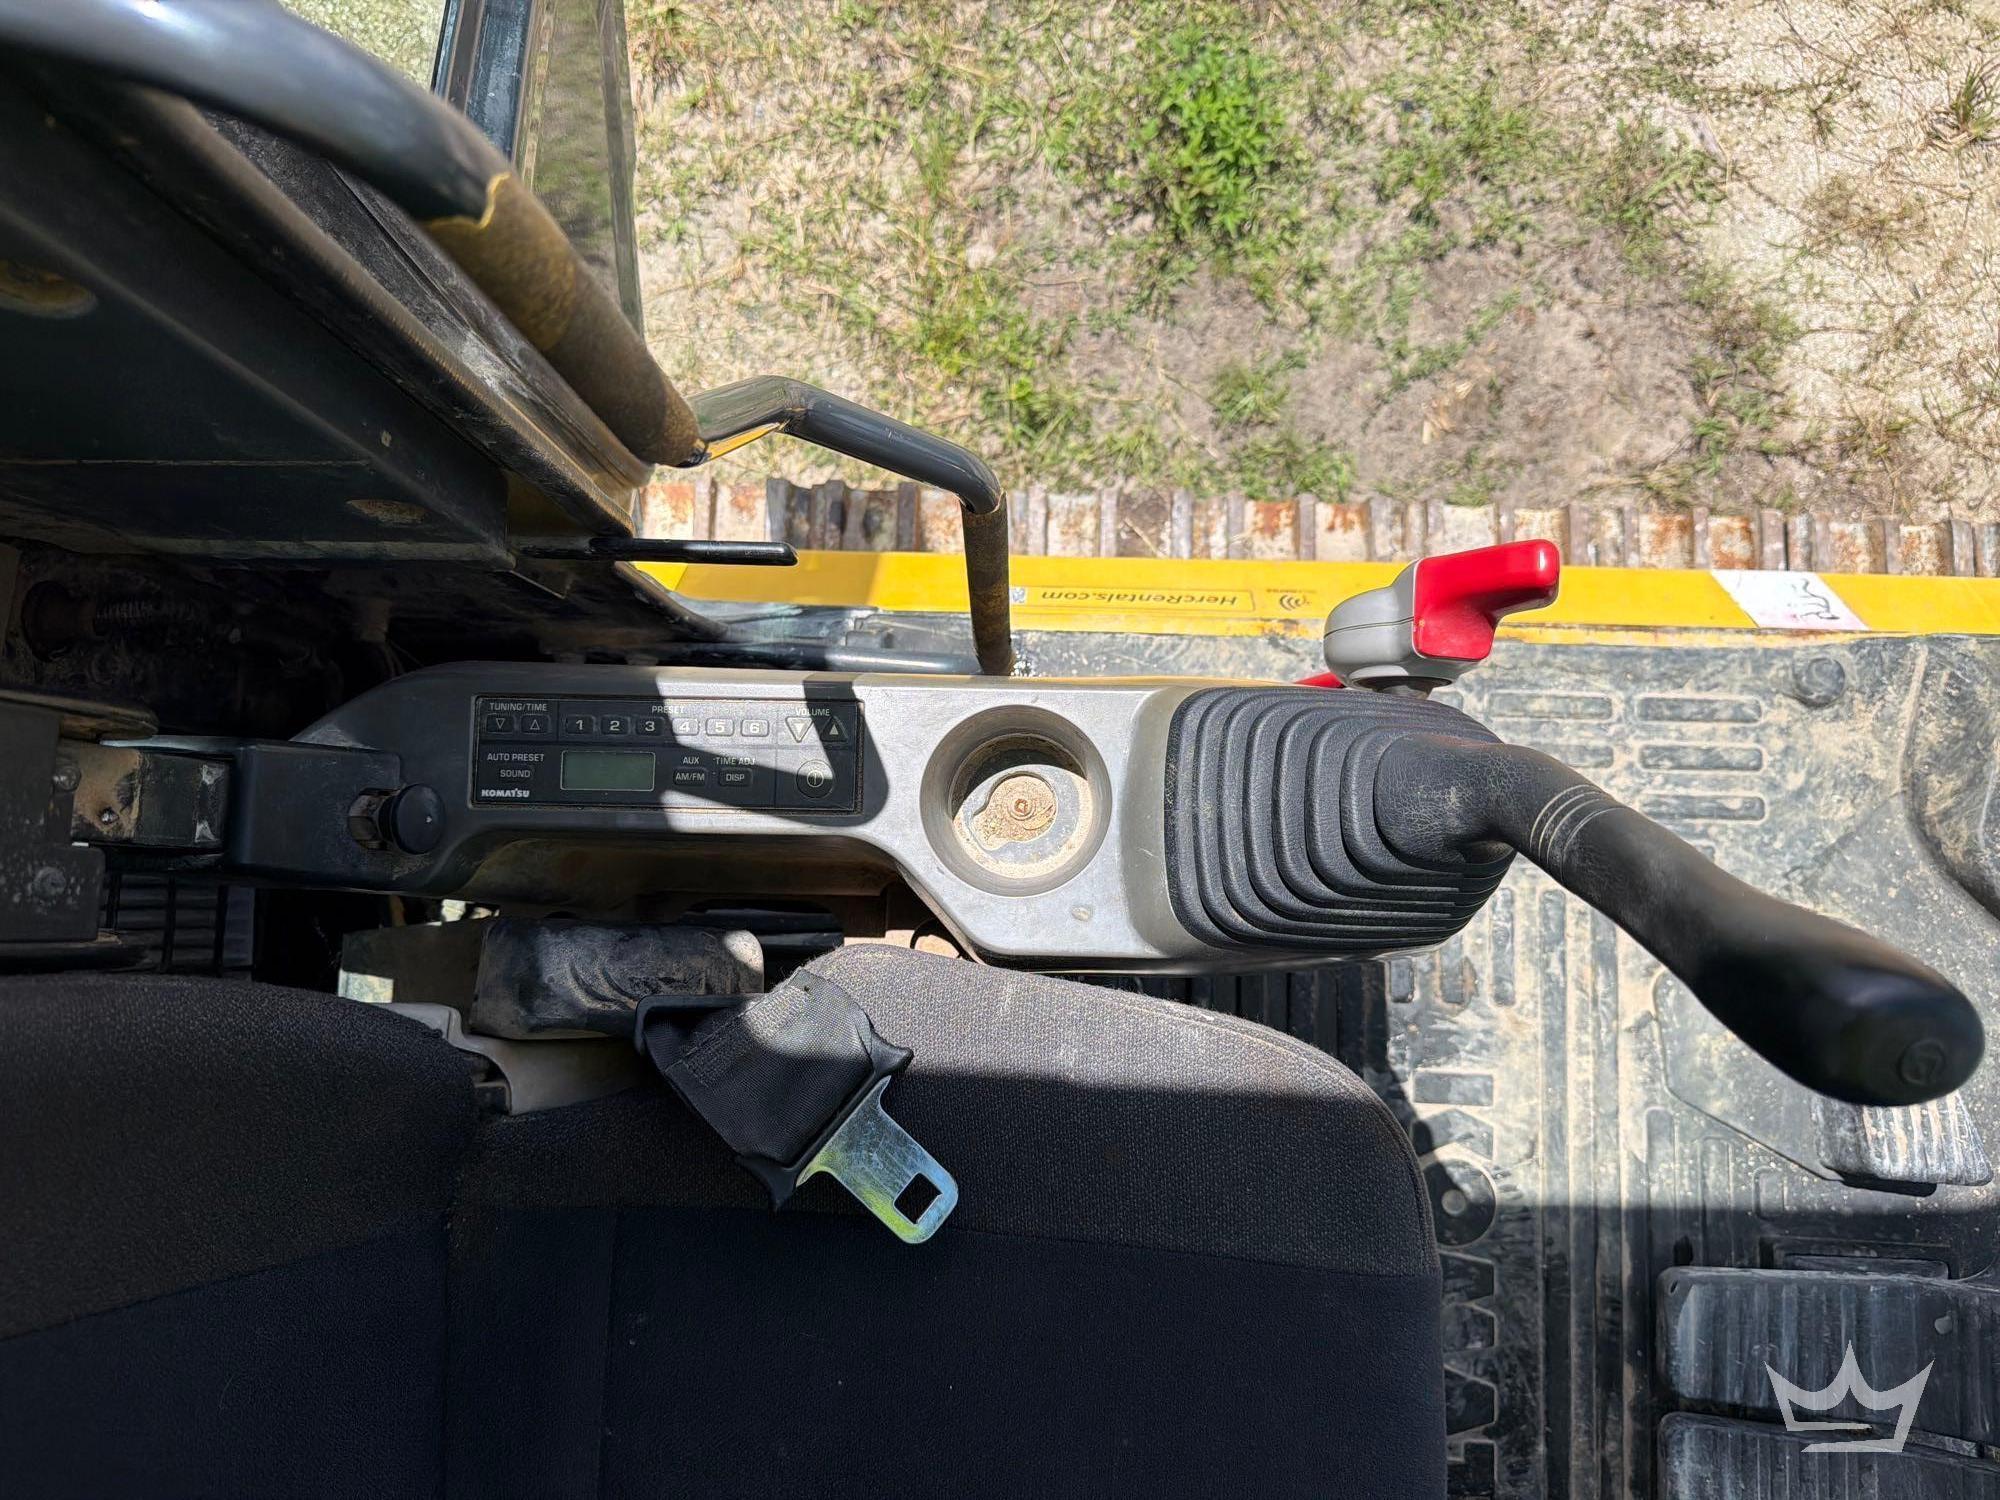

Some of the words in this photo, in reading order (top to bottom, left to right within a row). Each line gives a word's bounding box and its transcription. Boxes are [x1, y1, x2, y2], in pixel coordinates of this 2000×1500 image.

[1041, 590, 1237, 606] HercRentals.com
[489, 702, 548, 712] TUNING/TIME
[651, 705, 685, 714] PRESET
[795, 708, 830, 716] VOLUME
[575, 720, 584, 731] 1
[609, 720, 620, 731] 2
[644, 721, 656, 732] 3
[679, 721, 690, 733] 4
[714, 721, 726, 733] 5
[750, 721, 760, 733] 6
[486, 753, 511, 762] AUTO
[512, 753, 545, 762] PRESET
[682, 756, 700, 765] AUX
[715, 757, 736, 766] TIME
[738, 757, 756, 766] ADJ
[500, 769, 531, 778] SOUND
[675, 772, 706, 781] AM/FM
[725, 773, 746, 782] DISP
